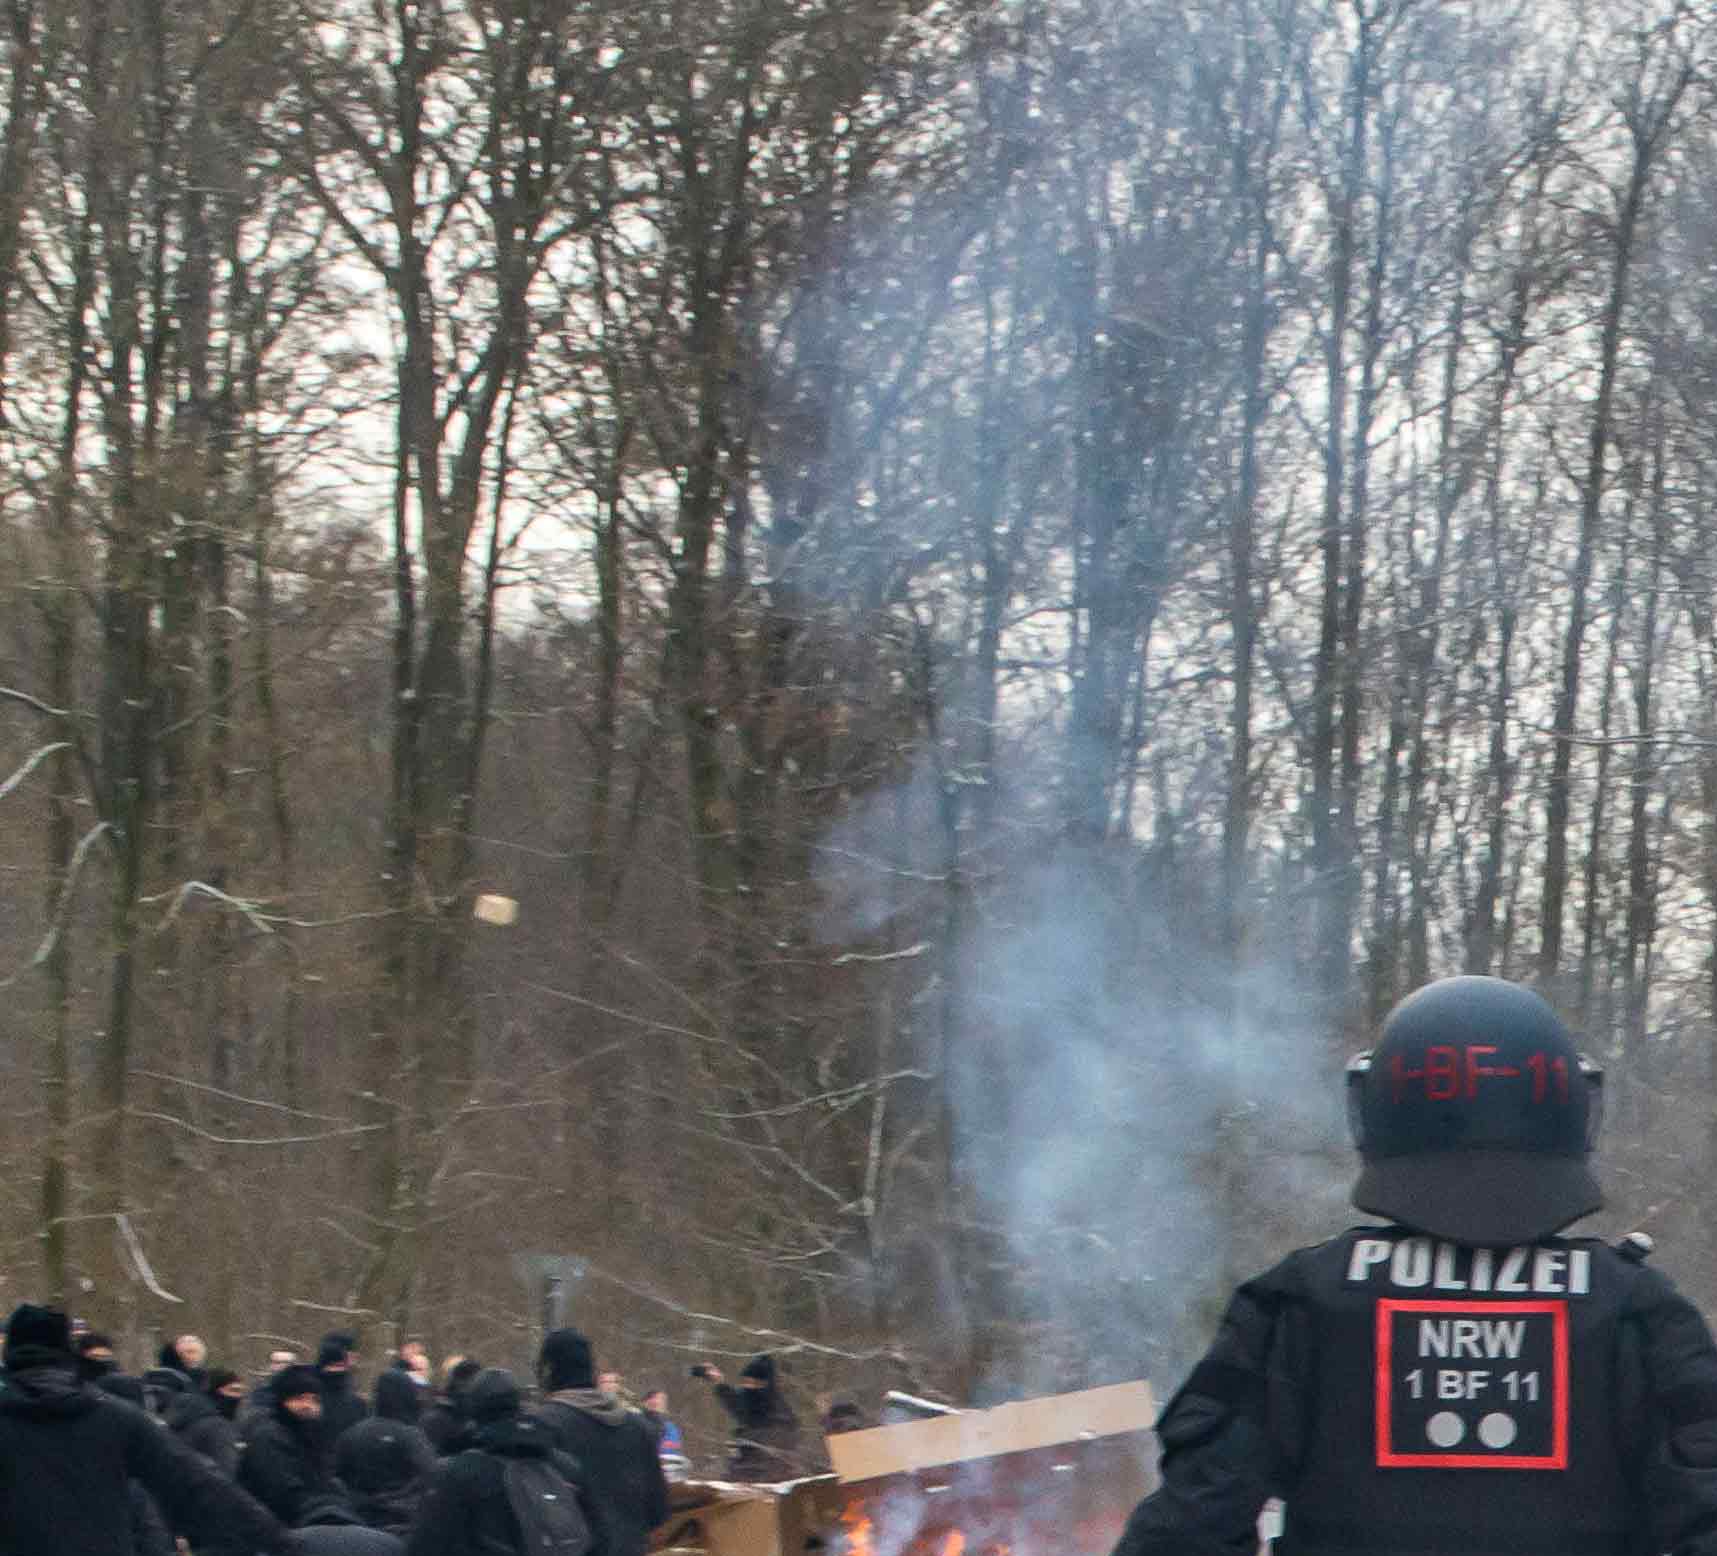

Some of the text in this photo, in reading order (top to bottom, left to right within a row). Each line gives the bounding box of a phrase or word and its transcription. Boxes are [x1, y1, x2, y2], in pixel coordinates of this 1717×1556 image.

[1346, 1237, 1592, 1295] POLIZEI
[1418, 1319, 1526, 1359] NRW
[1405, 1370, 1539, 1401] 1 BF 11
